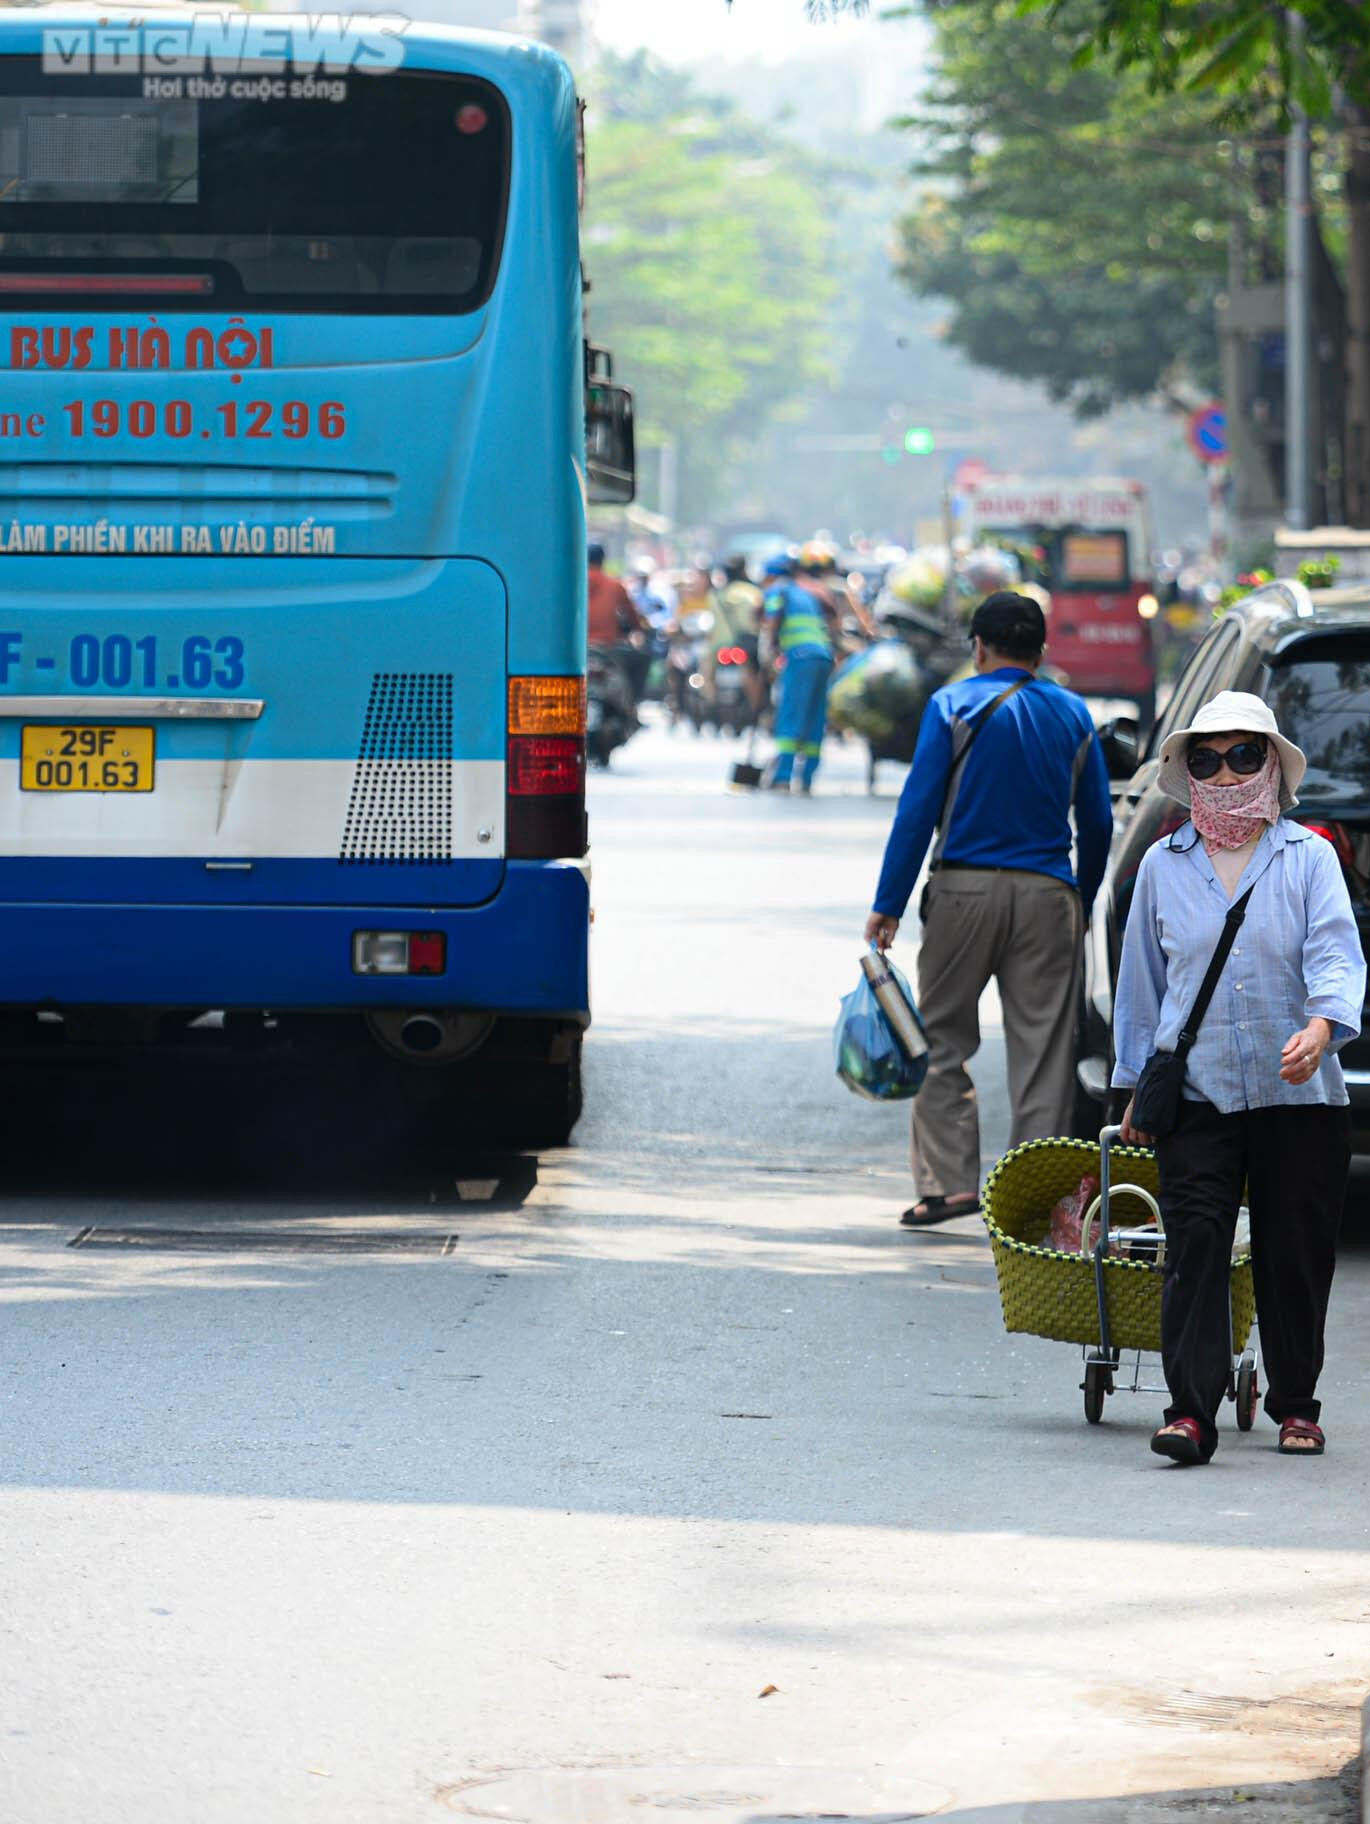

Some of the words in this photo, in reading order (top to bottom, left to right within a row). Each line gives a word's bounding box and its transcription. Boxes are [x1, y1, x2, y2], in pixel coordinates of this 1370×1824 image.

[10, 326, 94, 369] BUS
[108, 315, 170, 369] HÀ
[63, 399, 346, 439] 1900.1296
[0, 519, 46, 553] LÀM
[133, 525, 173, 553] KHI
[180, 525, 212, 553] RA
[219, 520, 267, 553] VÀO
[273, 516, 335, 553] ĐIỂM
[70, 634, 245, 689] 001.63
[59, 729, 116, 757] 29F
[36, 760, 139, 788] 001.63
